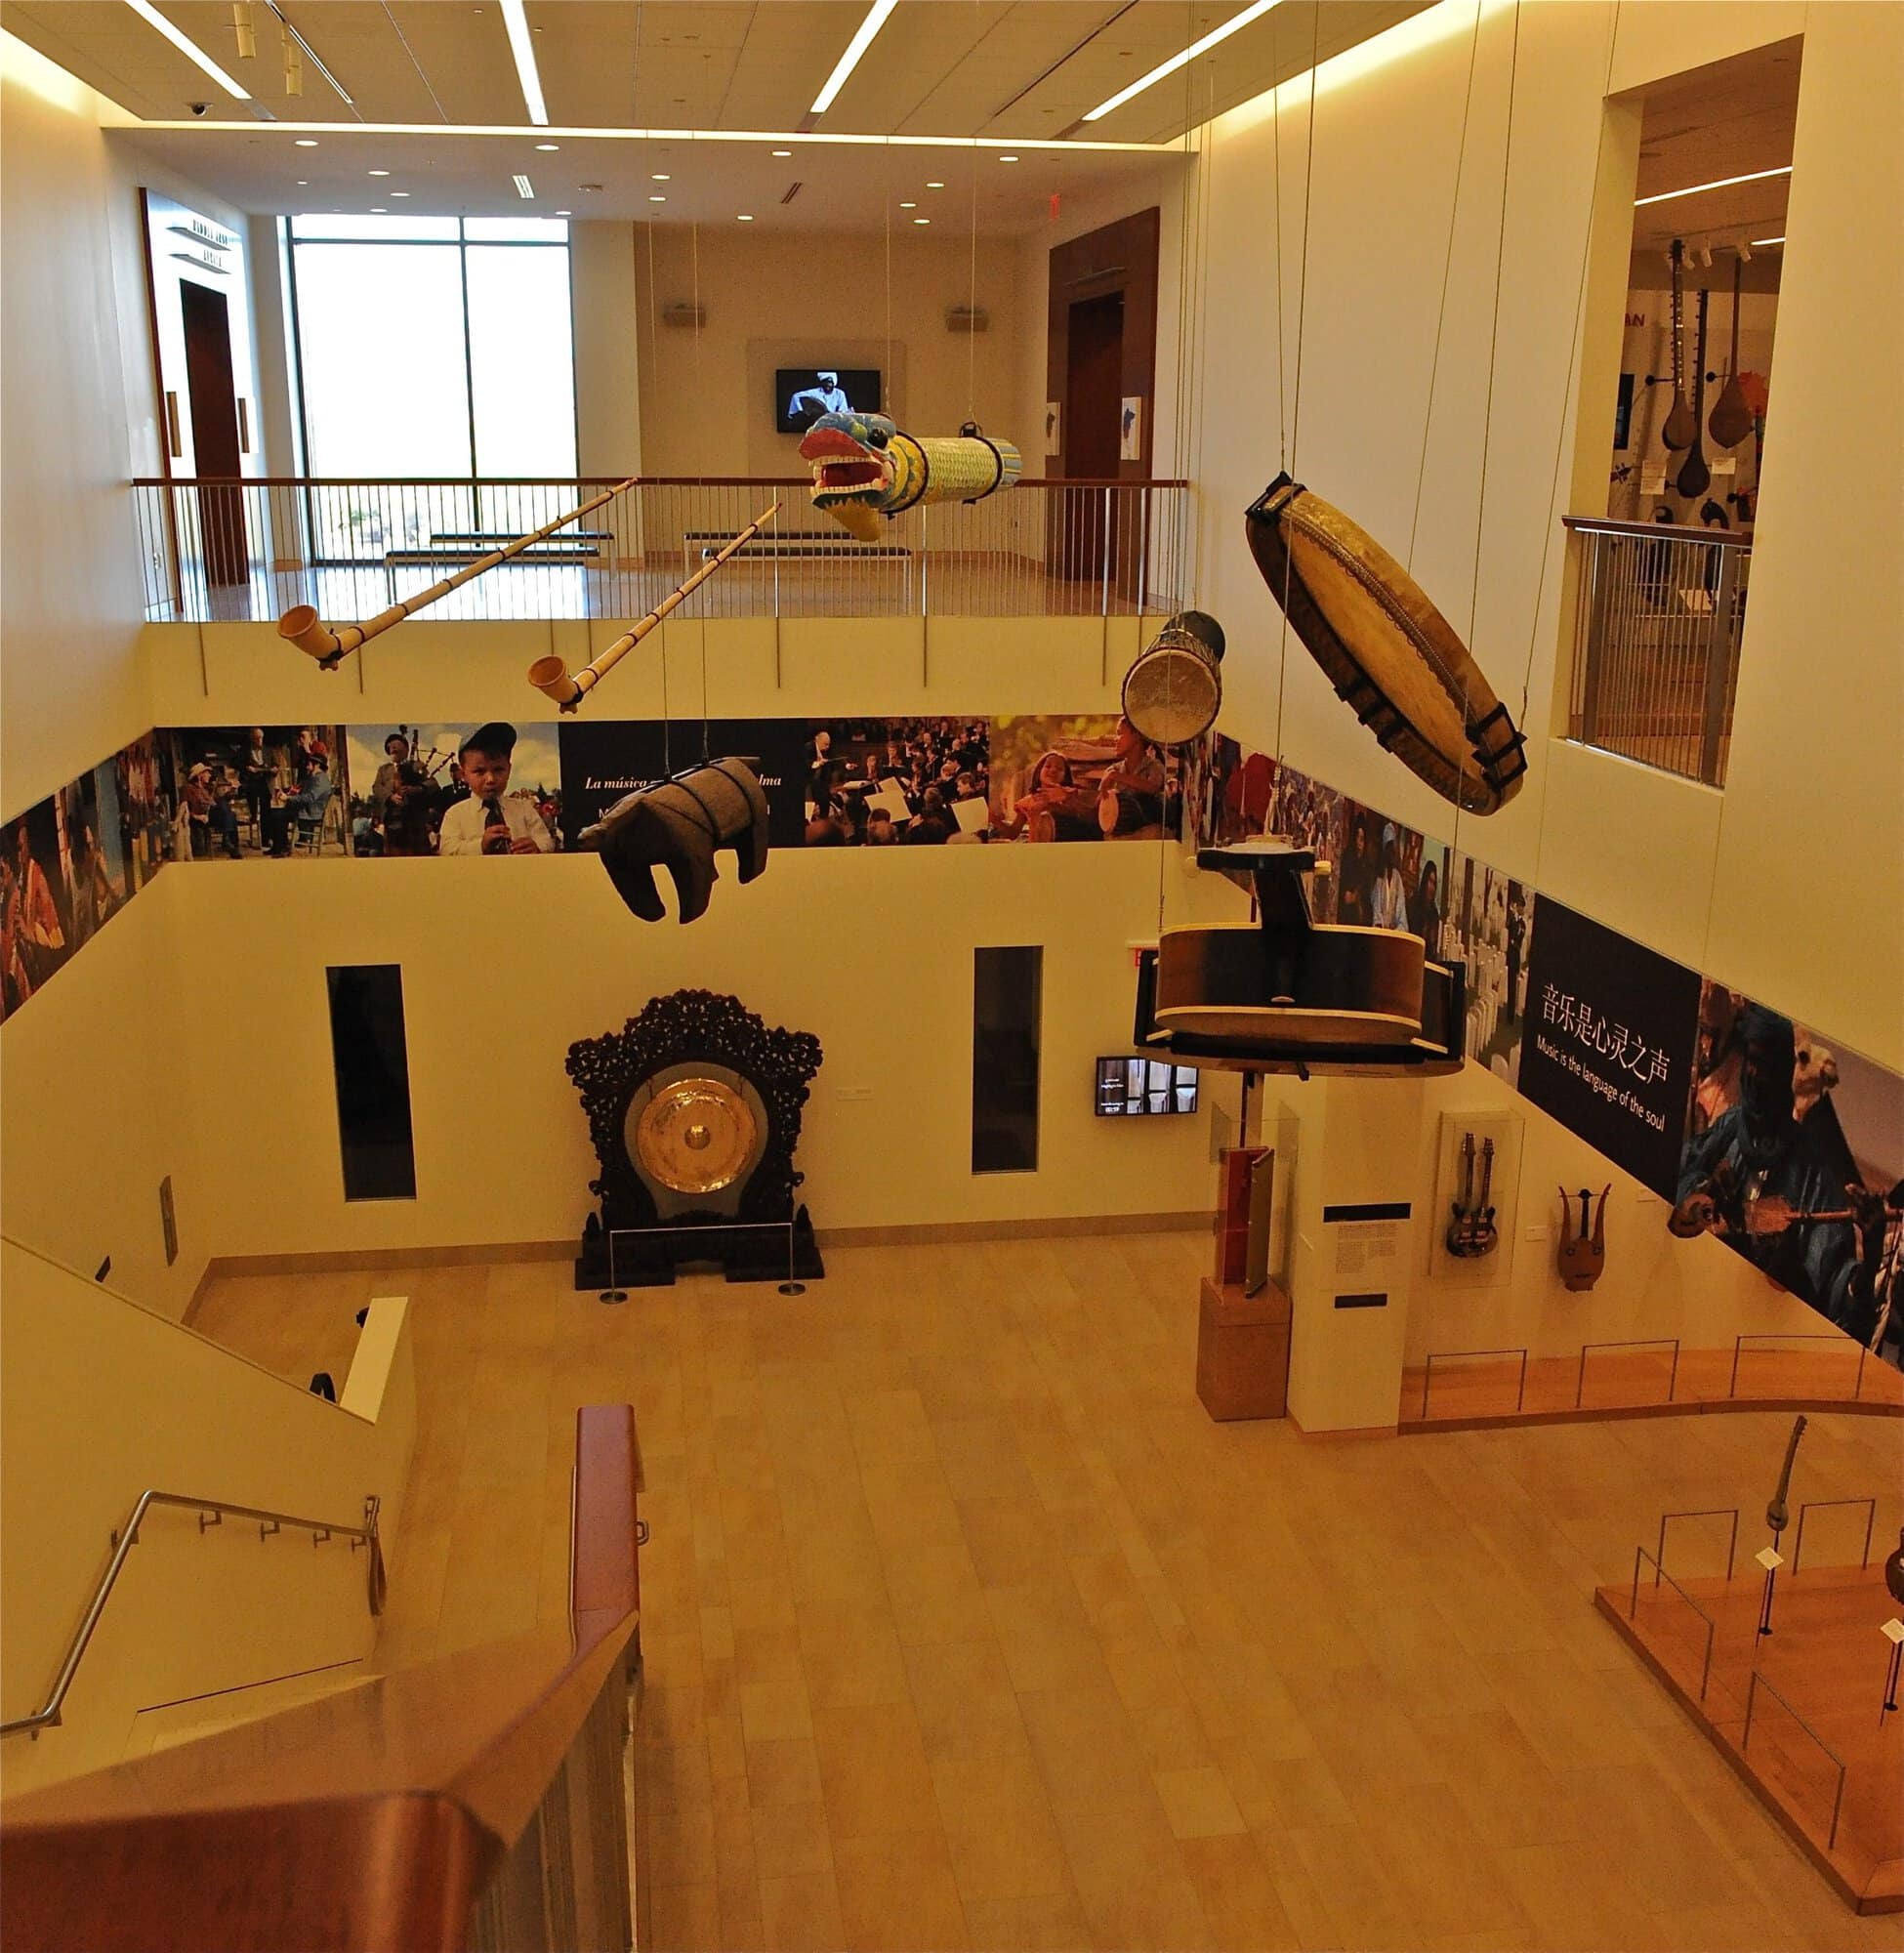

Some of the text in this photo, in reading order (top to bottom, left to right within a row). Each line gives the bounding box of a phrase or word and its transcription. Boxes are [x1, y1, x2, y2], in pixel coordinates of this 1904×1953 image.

[585, 773, 782, 789] La música lma
[1542, 983, 1671, 1084] 音乐是心灵之声
[1537, 1034, 1666, 1132] Music is the language of the soul
